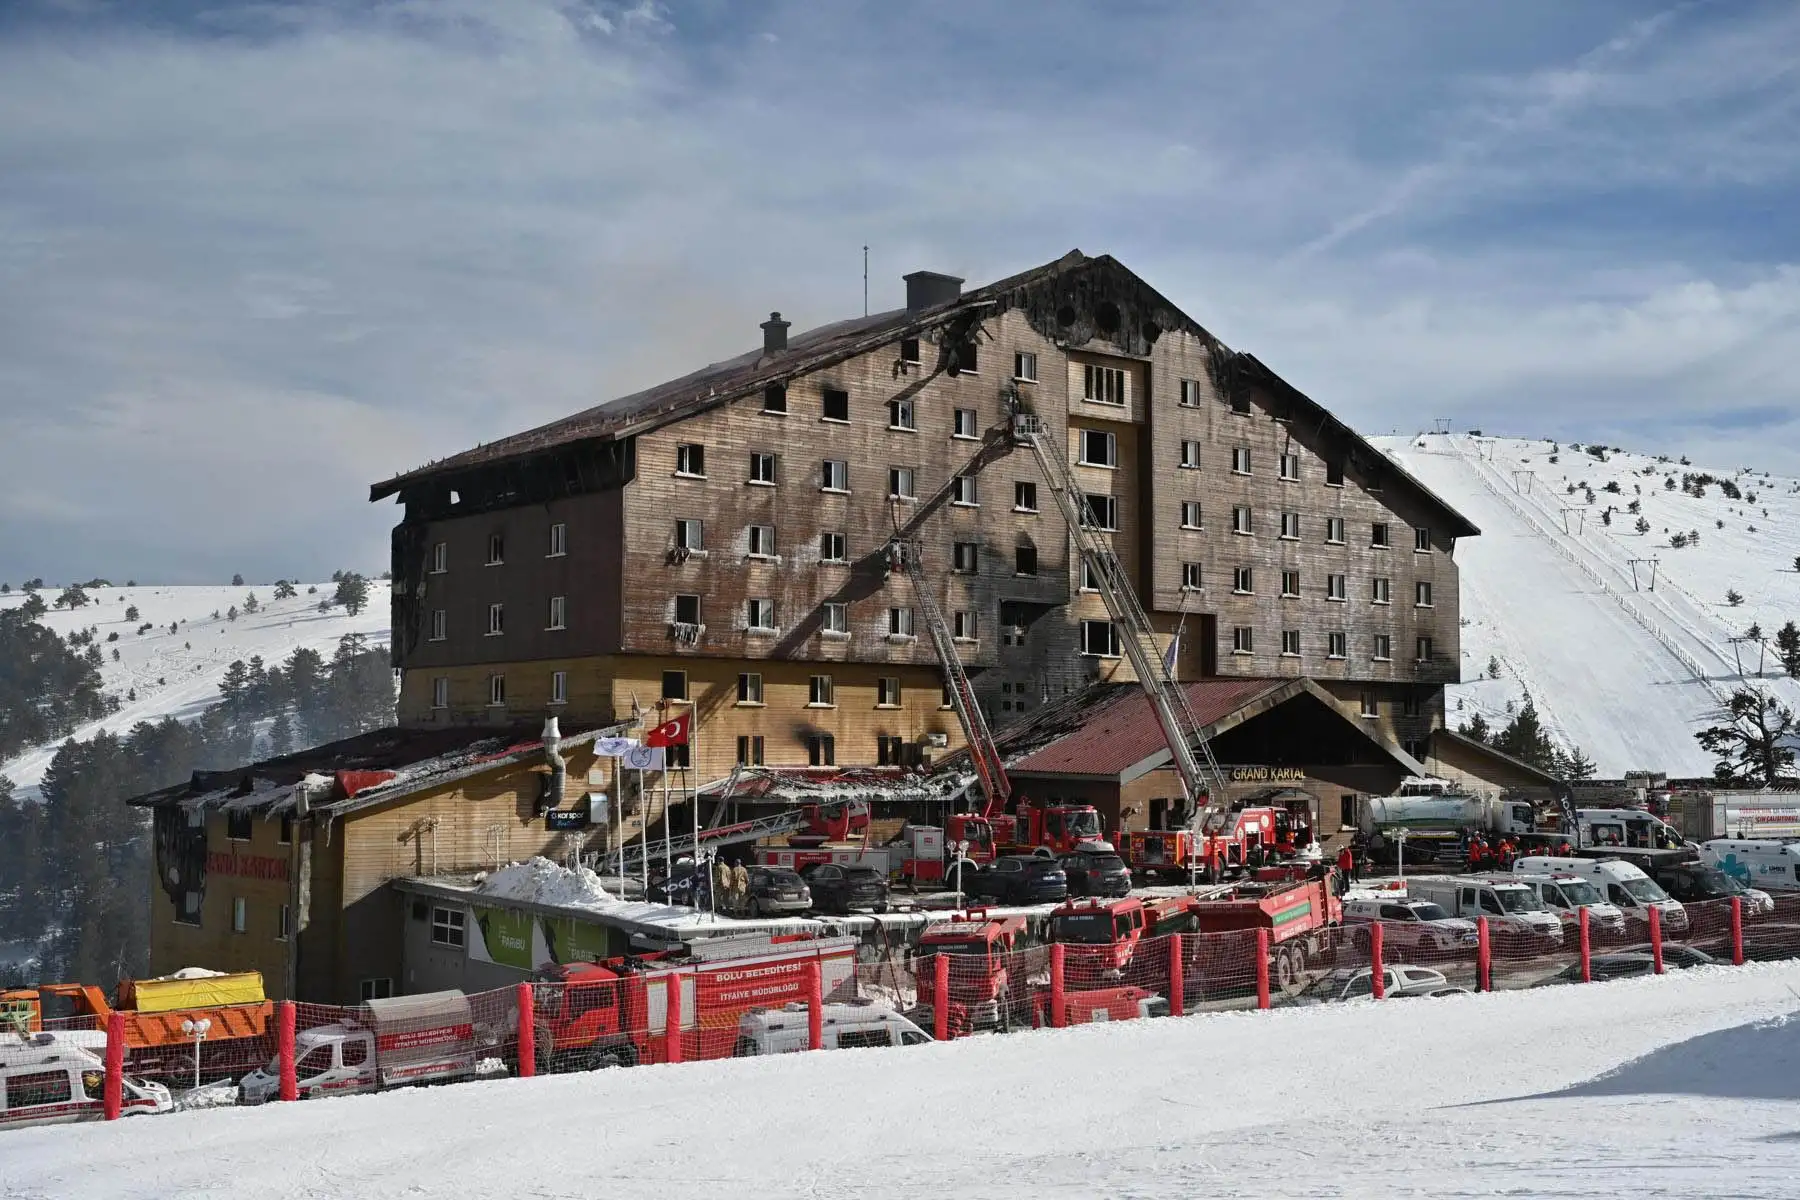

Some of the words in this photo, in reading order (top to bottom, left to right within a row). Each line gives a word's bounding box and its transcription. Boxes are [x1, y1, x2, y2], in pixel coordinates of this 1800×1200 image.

[1233, 767, 1268, 780] GRAND
[1270, 767, 1306, 779] KARTAL
[716, 971, 743, 982] BOLU
[720, 990, 749, 1001] İTFAİYE
